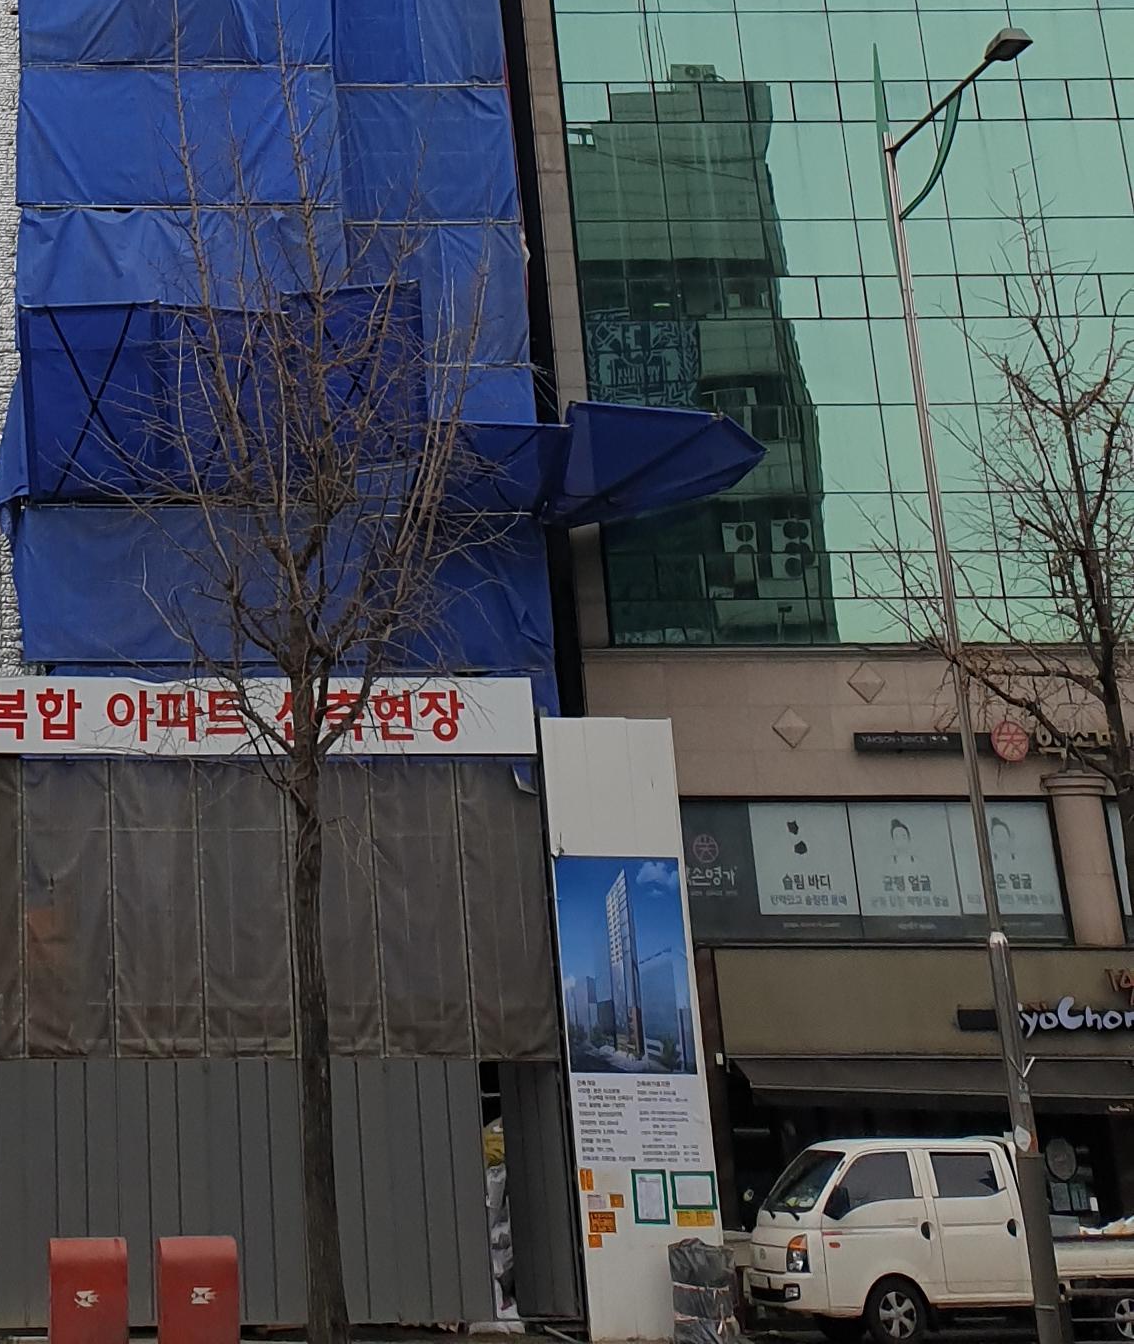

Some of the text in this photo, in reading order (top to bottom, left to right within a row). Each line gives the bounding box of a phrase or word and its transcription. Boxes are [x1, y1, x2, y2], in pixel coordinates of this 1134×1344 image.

[106, 690, 248, 743] 아파트
[687, 865, 738, 888] 손명가
[808, 873, 832, 891] 바디
[1018, 995, 1134, 1039] yoCho
